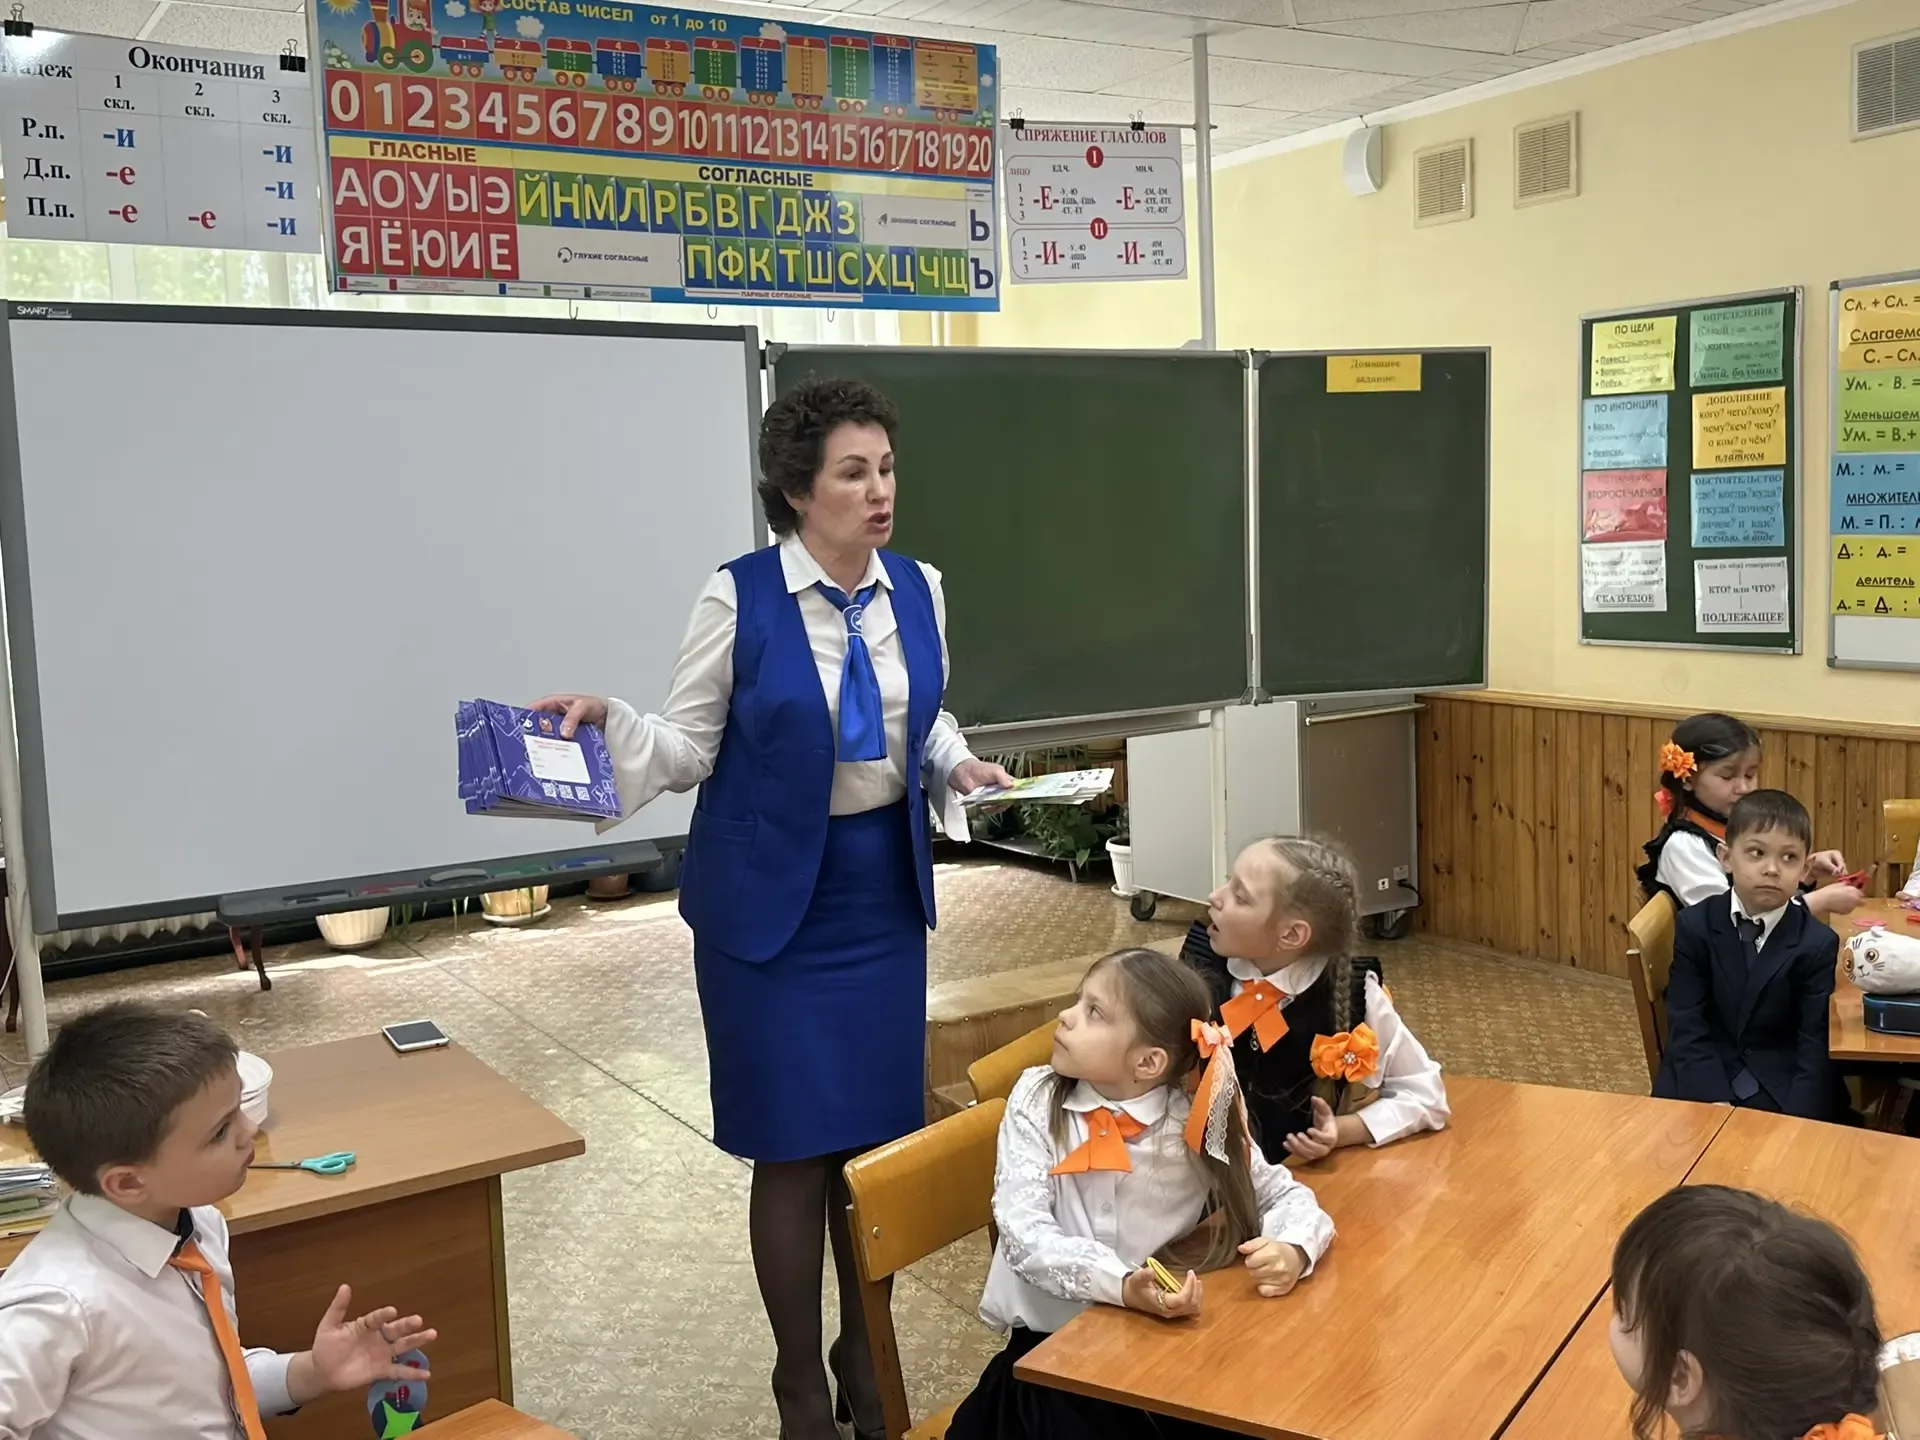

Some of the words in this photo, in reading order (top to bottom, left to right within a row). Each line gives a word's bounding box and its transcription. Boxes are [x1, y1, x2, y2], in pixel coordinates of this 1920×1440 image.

[576, 4, 635, 22] ЧИСЕЛ
[650, 15, 667, 26] от
[672, 15, 680, 27] 1
[686, 18, 703, 31] до
[709, 19, 727, 32] 10
[461, 39, 467, 49] 1
[515, 41, 521, 50] 2
[615, 41, 621, 50] 4
[665, 40, 671, 49] 5
[711, 40, 718, 49] 6
[758, 39, 764, 48] 7
[886, 38, 897, 46] 10
[128, 46, 266, 80] Окончания
[115, 75, 121, 89] 1
[195, 83, 204, 96] 2
[272, 90, 280, 104] 3
[104, 97, 135, 111] скл.
[185, 104, 215, 118] скл.
[262, 111, 292, 125] скл.
[330, 80, 360, 122] 0
[373, 83, 393, 125] 1
[407, 85, 435, 128] 2
[444, 88, 471, 130] 3
[478, 92, 508, 133] 4
[516, 95, 541, 135] 5
[549, 98, 576, 139] 6
[583, 101, 607, 141] 7
[615, 103, 642, 144] 8
[649, 107, 675, 146] 9
[679, 110, 708, 149] 10
[711, 112, 737, 152] 11
[742, 115, 770, 155] 12
[771, 118, 799, 158] 13
[802, 121, 828, 160] 14
[831, 124, 857, 162] 15
[859, 126, 885, 165] 16
[888, 129, 914, 167] 17
[915, 131, 940, 169] 18
[942, 133, 966, 170] 19
[968, 135, 993, 173] 20
[22, 117, 65, 140] Р.п.
[103, 128, 135, 148] -и
[263, 145, 292, 163] -и
[1016, 128, 1098, 143] СПРЯЖЕНИЕ
[1101, 131, 1167, 144] ГЛАГОЛОВ
[369, 141, 477, 163] ГЛАСНЫЕ
[24, 157, 71, 180] Д.п.
[106, 166, 135, 185] -е
[265, 181, 294, 200] -и
[698, 165, 814, 188] СОГЛАСНЫЕ
[27, 197, 75, 219] П.п.
[109, 204, 138, 223] -е
[188, 210, 216, 229] -е
[267, 217, 297, 235] -и
[574, 252, 602, 260] ГЛУХИЕ
[604, 254, 648, 262] СОГЛАСНЫЕ
[17, 305, 48, 315] SMART
[1844, 298, 1867, 312] Сл.
[1884, 295, 1908, 308] Сл.
[1615, 325, 1628, 335] ПО
[1630, 322, 1654, 333] ЦЕЛИ
[1863, 349, 1881, 363] С.
[1845, 377, 1871, 391] Ум.
[1893, 376, 1906, 389] В.
[1706, 392, 1772, 406] ДОПОЛНЕНИЕ
[1843, 427, 1871, 442] Ум.
[1846, 492, 1920, 504] МНОЖИТЕЛ
[1856, 576, 1915, 588] делитель
[1702, 612, 1784, 623] ПОДЛЕЖАЩЕЕ
